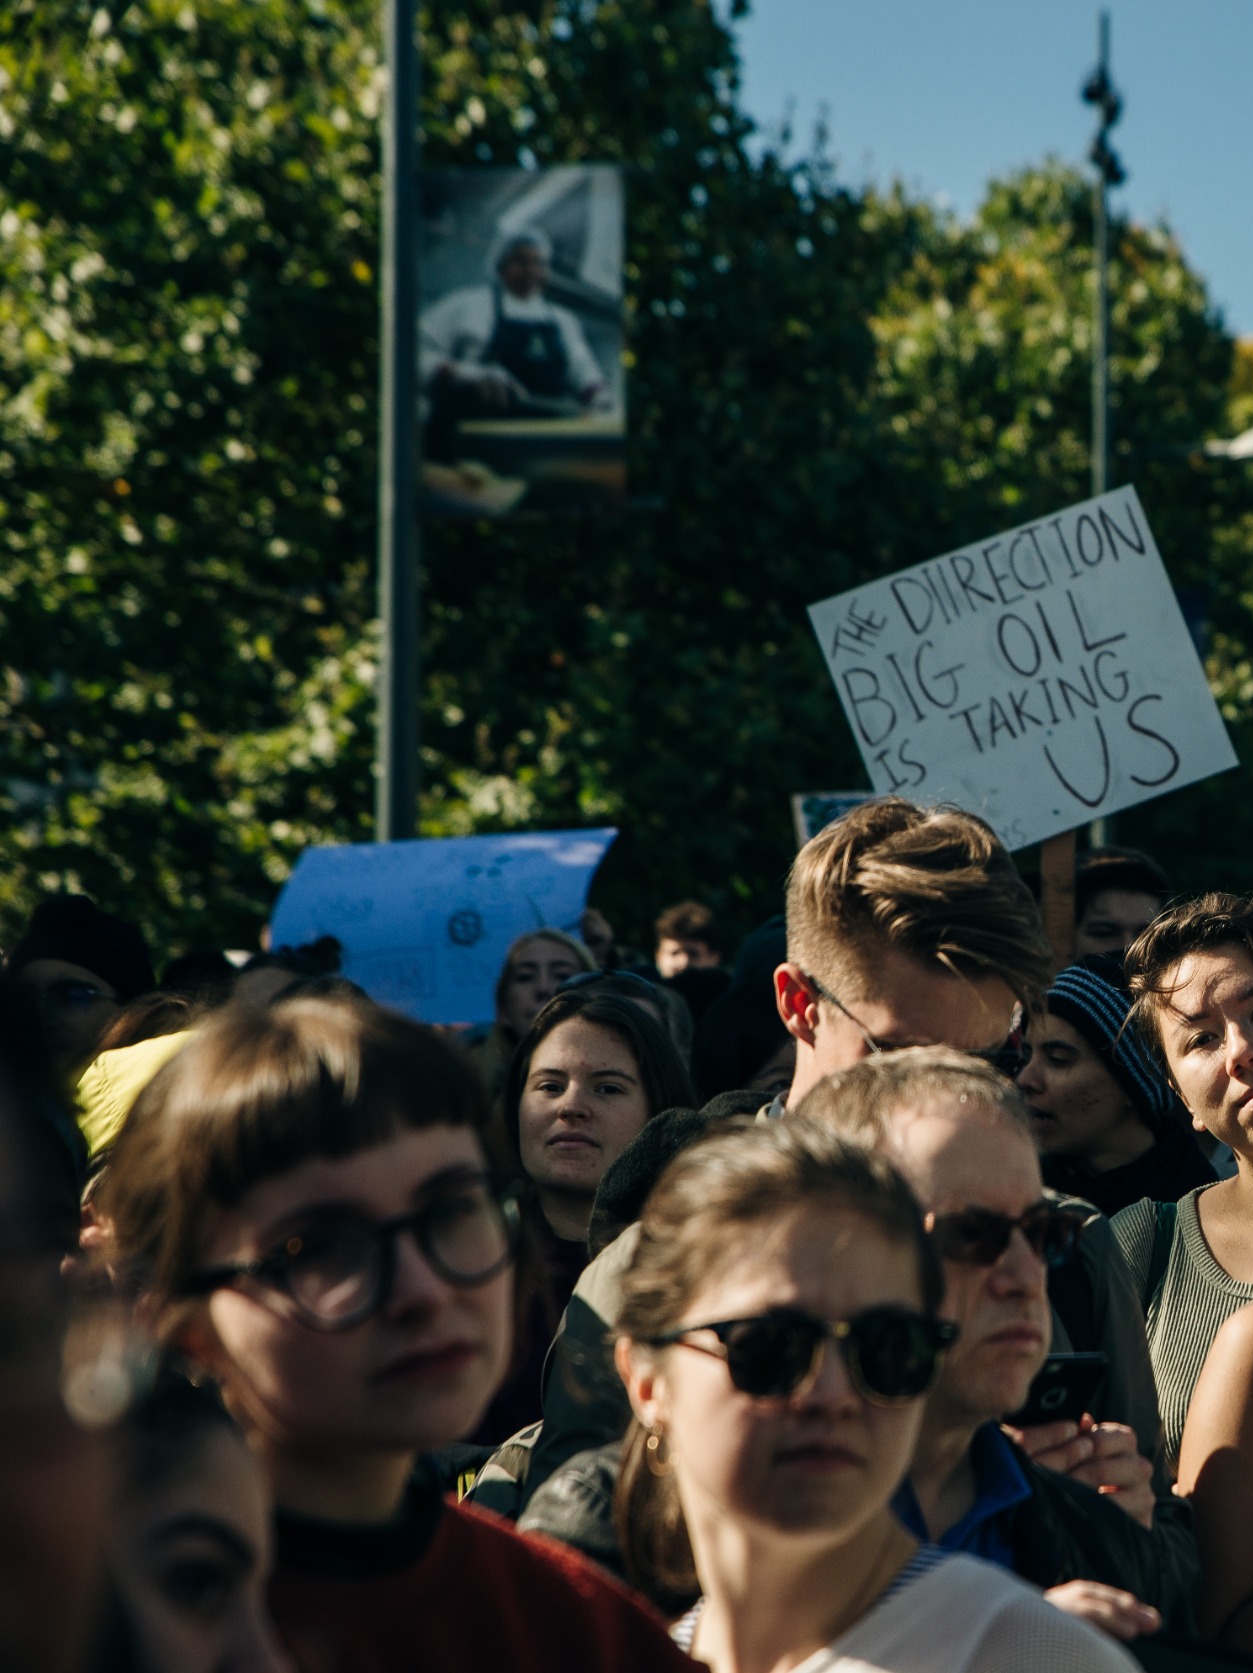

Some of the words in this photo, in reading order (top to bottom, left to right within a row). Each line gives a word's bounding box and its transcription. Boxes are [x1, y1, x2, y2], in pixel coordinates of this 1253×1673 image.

[832, 597, 888, 659] THE
[842, 640, 966, 748] BIG
[996, 589, 1127, 677] OIL
[873, 738, 927, 793] IS
[949, 650, 1130, 753] TAKING
[1043, 694, 1180, 808] US
